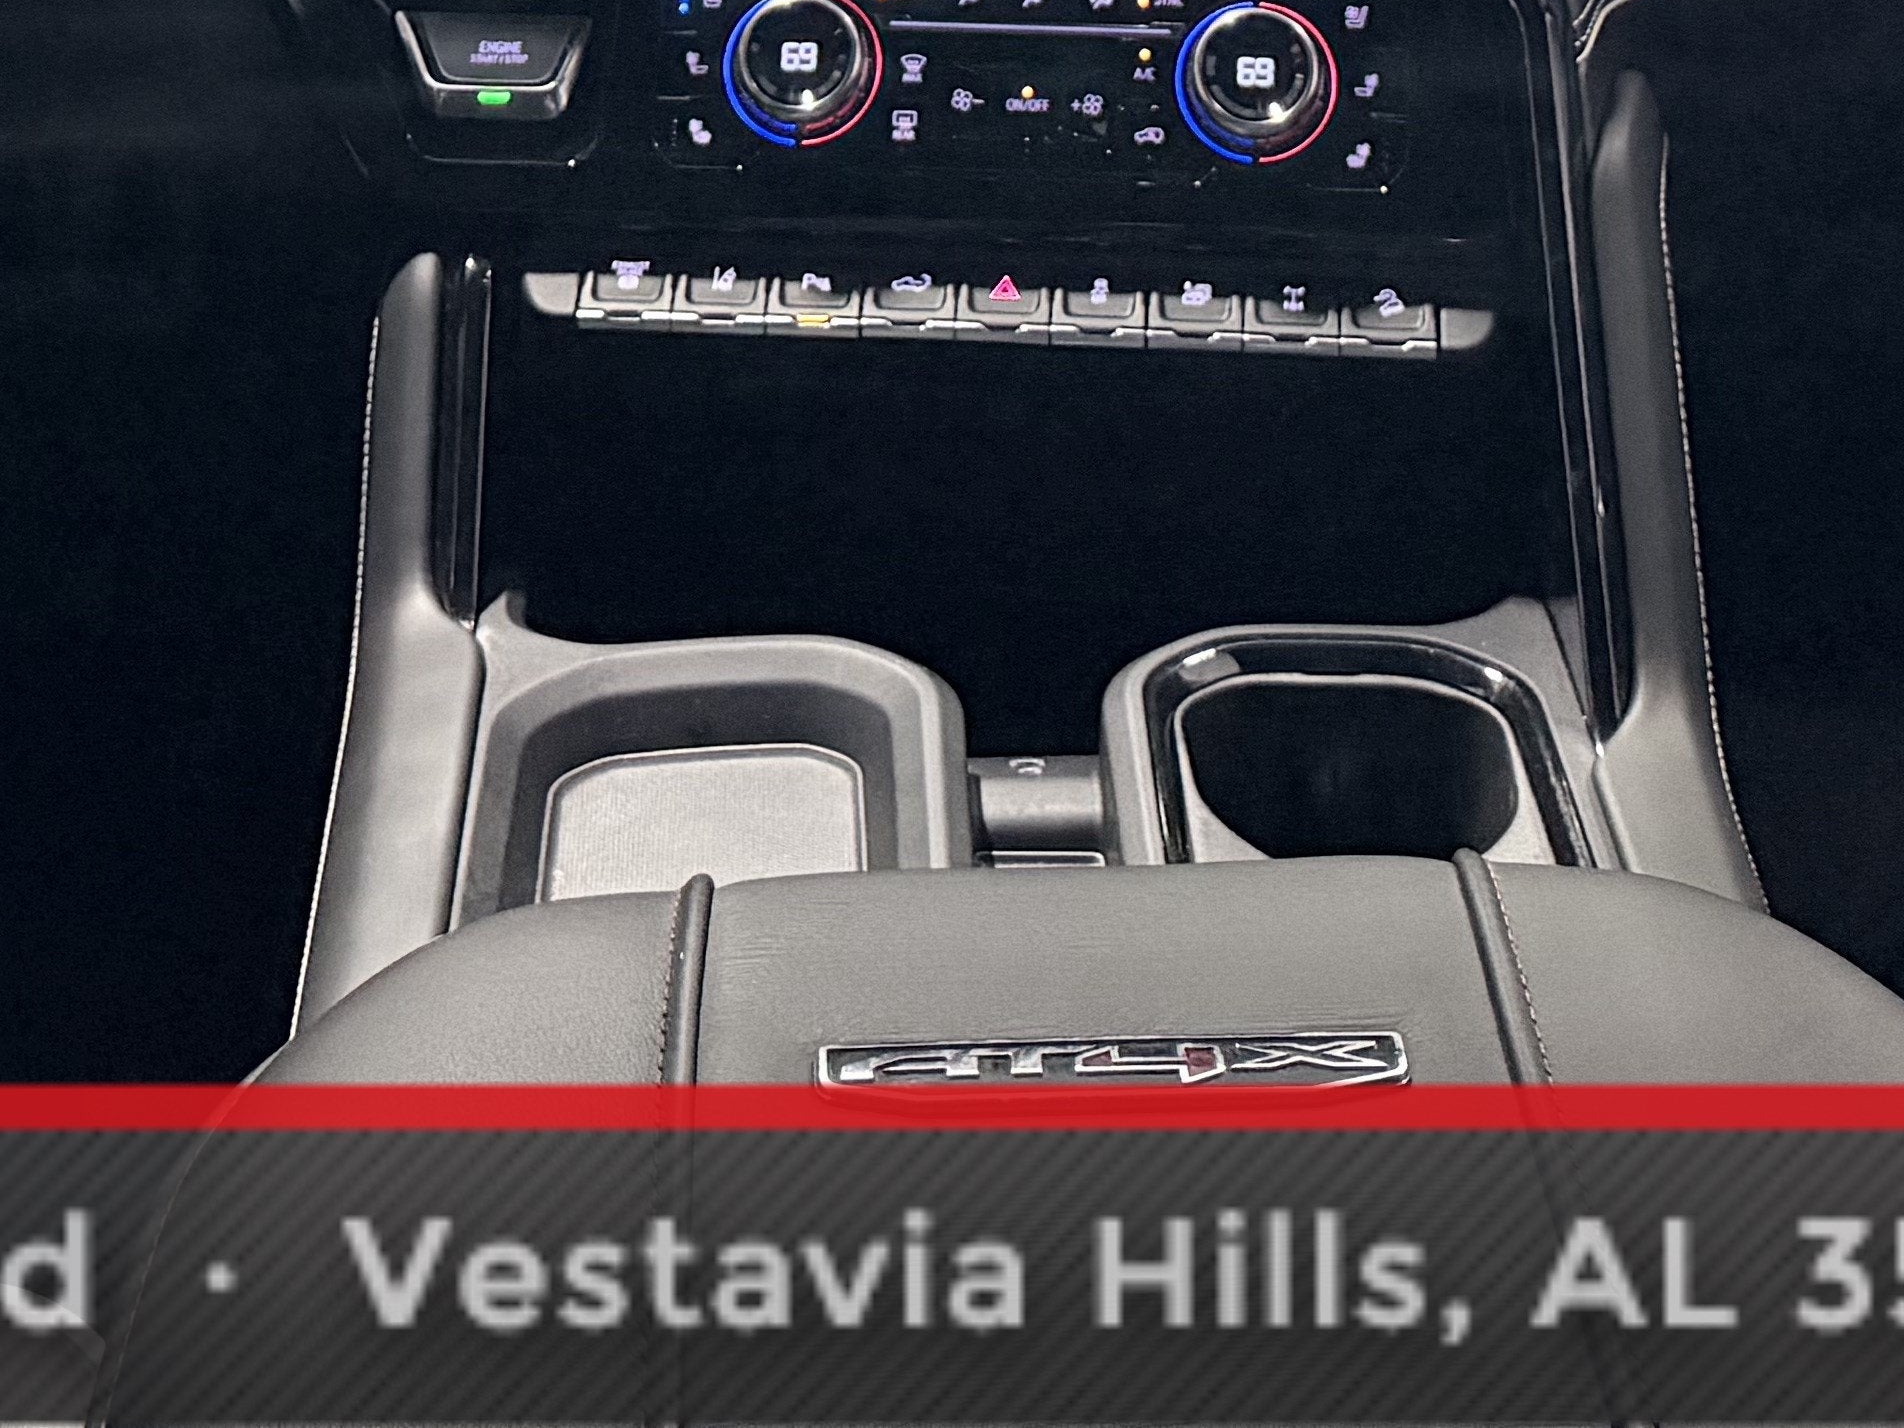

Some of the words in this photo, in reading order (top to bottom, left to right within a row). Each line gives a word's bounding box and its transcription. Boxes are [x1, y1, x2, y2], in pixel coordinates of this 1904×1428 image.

[780, 41, 819, 73] 69
[1235, 55, 1276, 89] 69
[1005, 97, 1051, 113] ON/OFF
